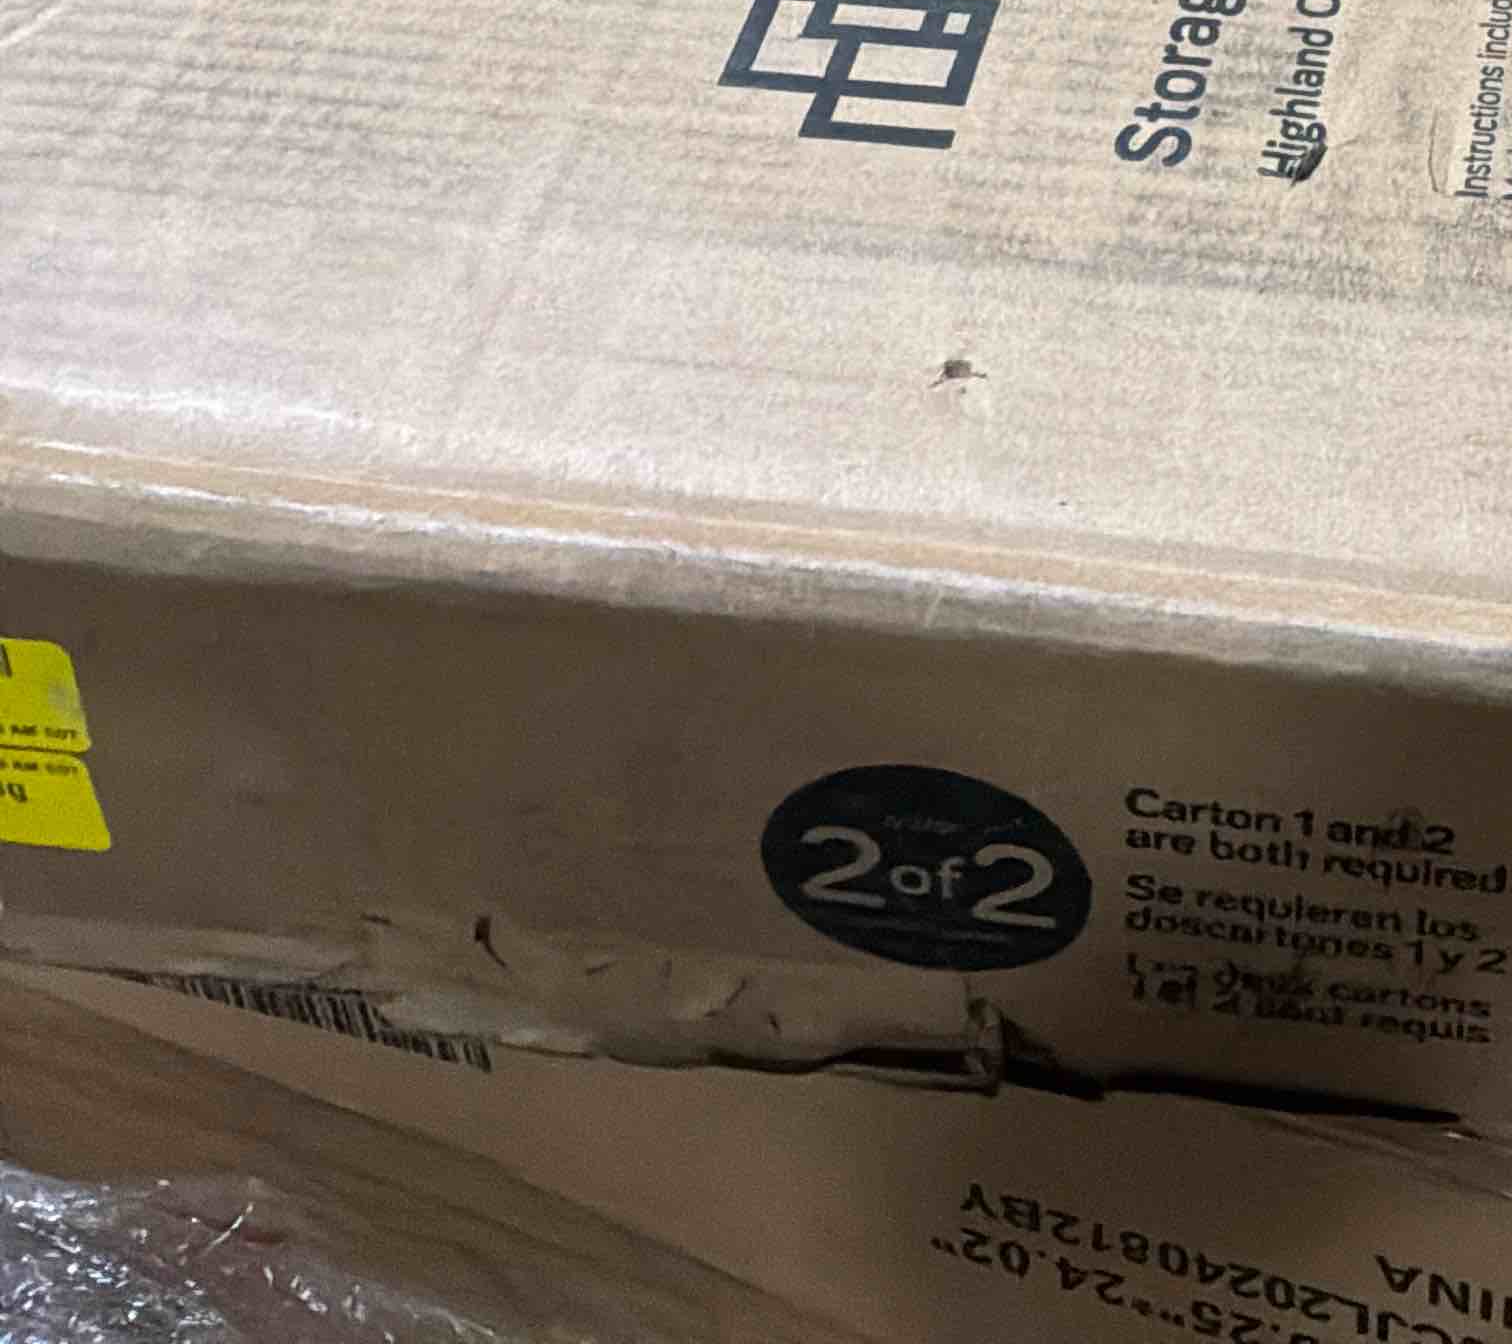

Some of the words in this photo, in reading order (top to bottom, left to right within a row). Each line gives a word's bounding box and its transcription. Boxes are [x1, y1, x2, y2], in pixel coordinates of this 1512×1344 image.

[1257, 27, 1334, 179] Highland
[1455, 65, 1506, 199] Instructions
[1124, 787, 1279, 837] Carton
[1294, 810, 1315, 841] 1
[1324, 816, 1414, 853] and
[1422, 825, 1457, 855] 2
[1124, 825, 1195, 858] are
[1209, 833, 1310, 874] both
[1323, 853, 1509, 898] required
[799, 825, 886, 909] 2
[888, 855, 965, 900] of
[971, 843, 1058, 929] 2
[1124, 872, 1185, 906] Se
[1415, 909, 1482, 944] los
[1405, 941, 1426, 968] 1
[1435, 948, 1471, 978] y
[1481, 948, 1510, 976] 2
[960, 1182, 1500, 1344] CJL20240812BY
